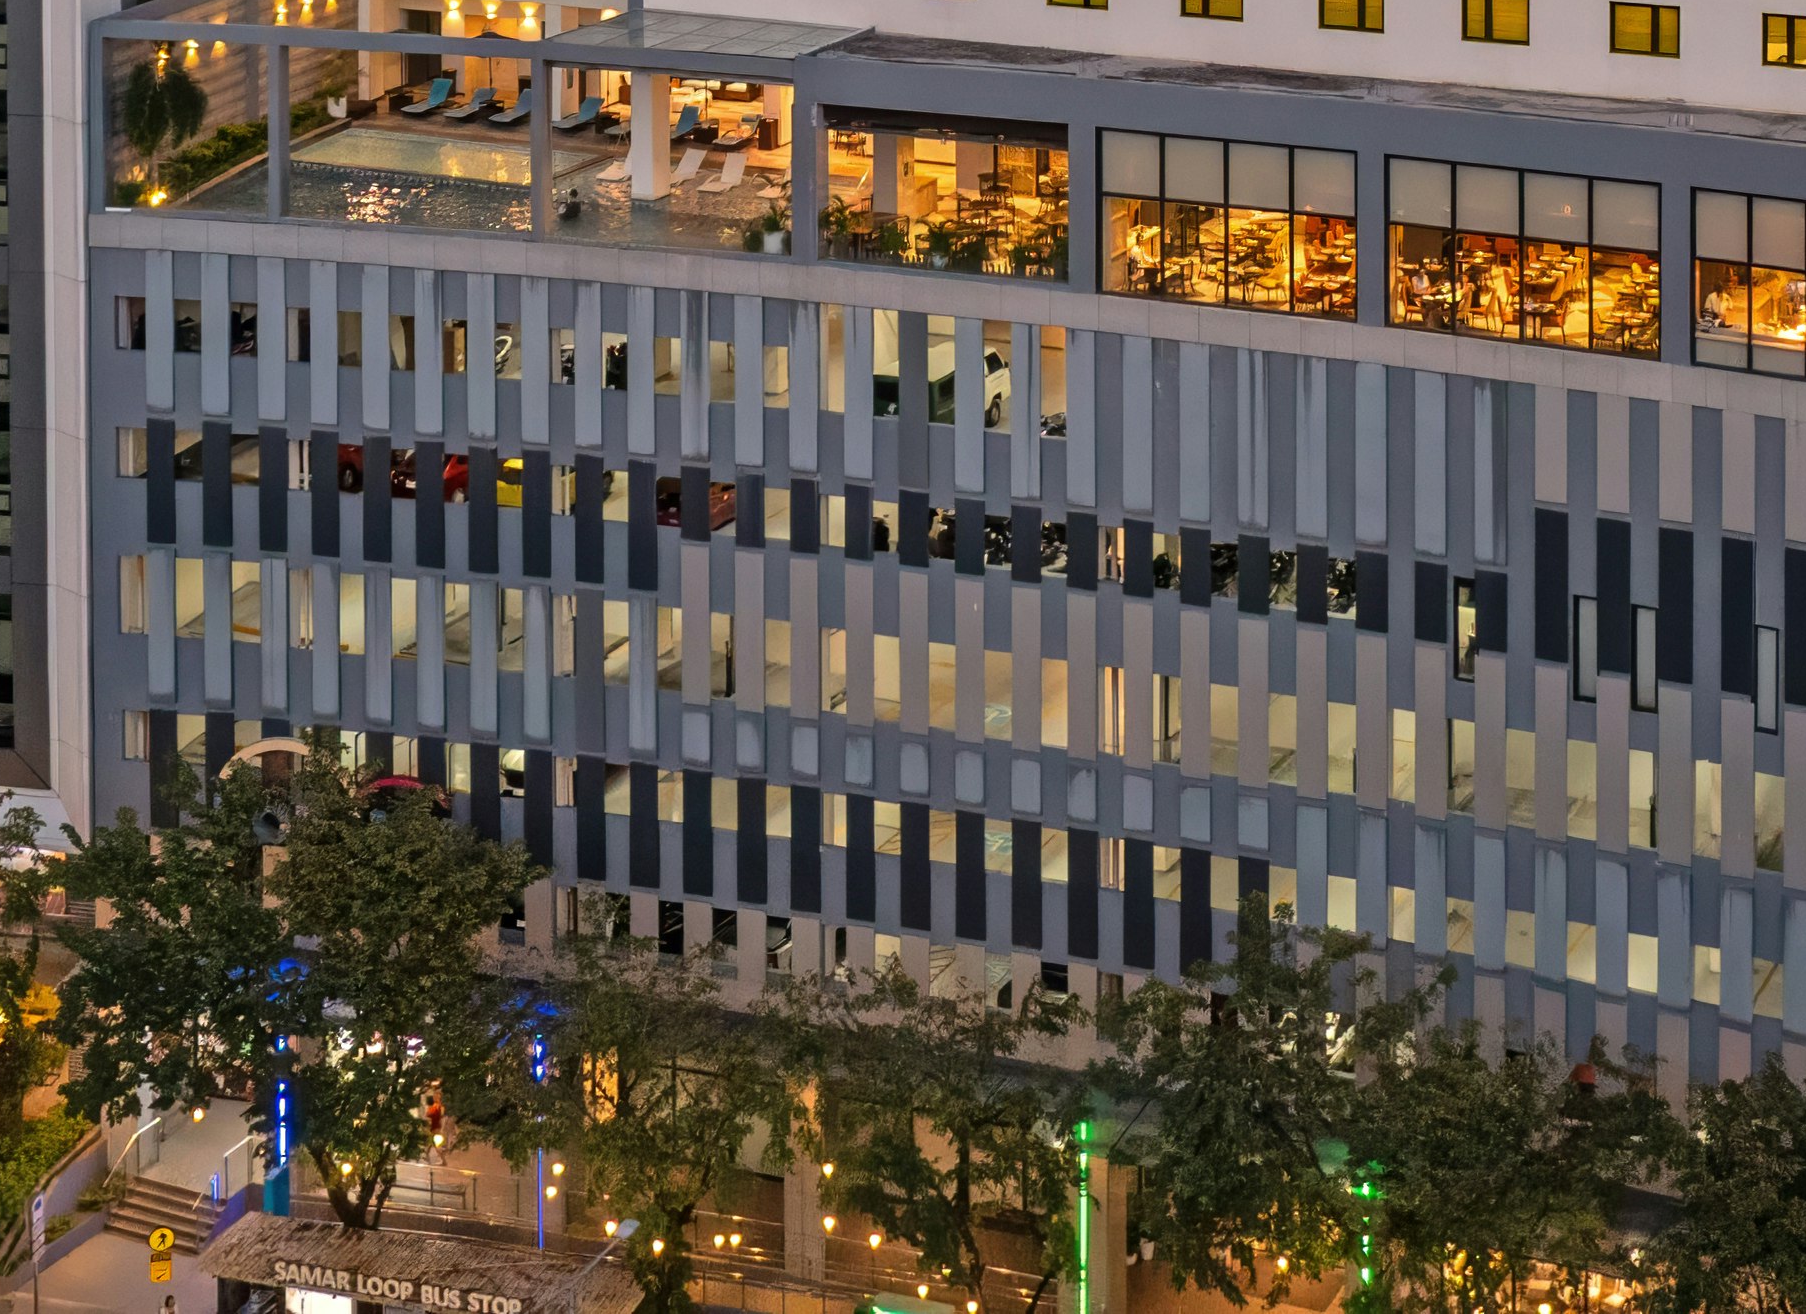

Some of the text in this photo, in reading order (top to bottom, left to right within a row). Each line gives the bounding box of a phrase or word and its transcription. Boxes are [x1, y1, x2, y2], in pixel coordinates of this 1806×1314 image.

[274, 1261, 523, 1314] SAMAR LOOP BUS STOP
